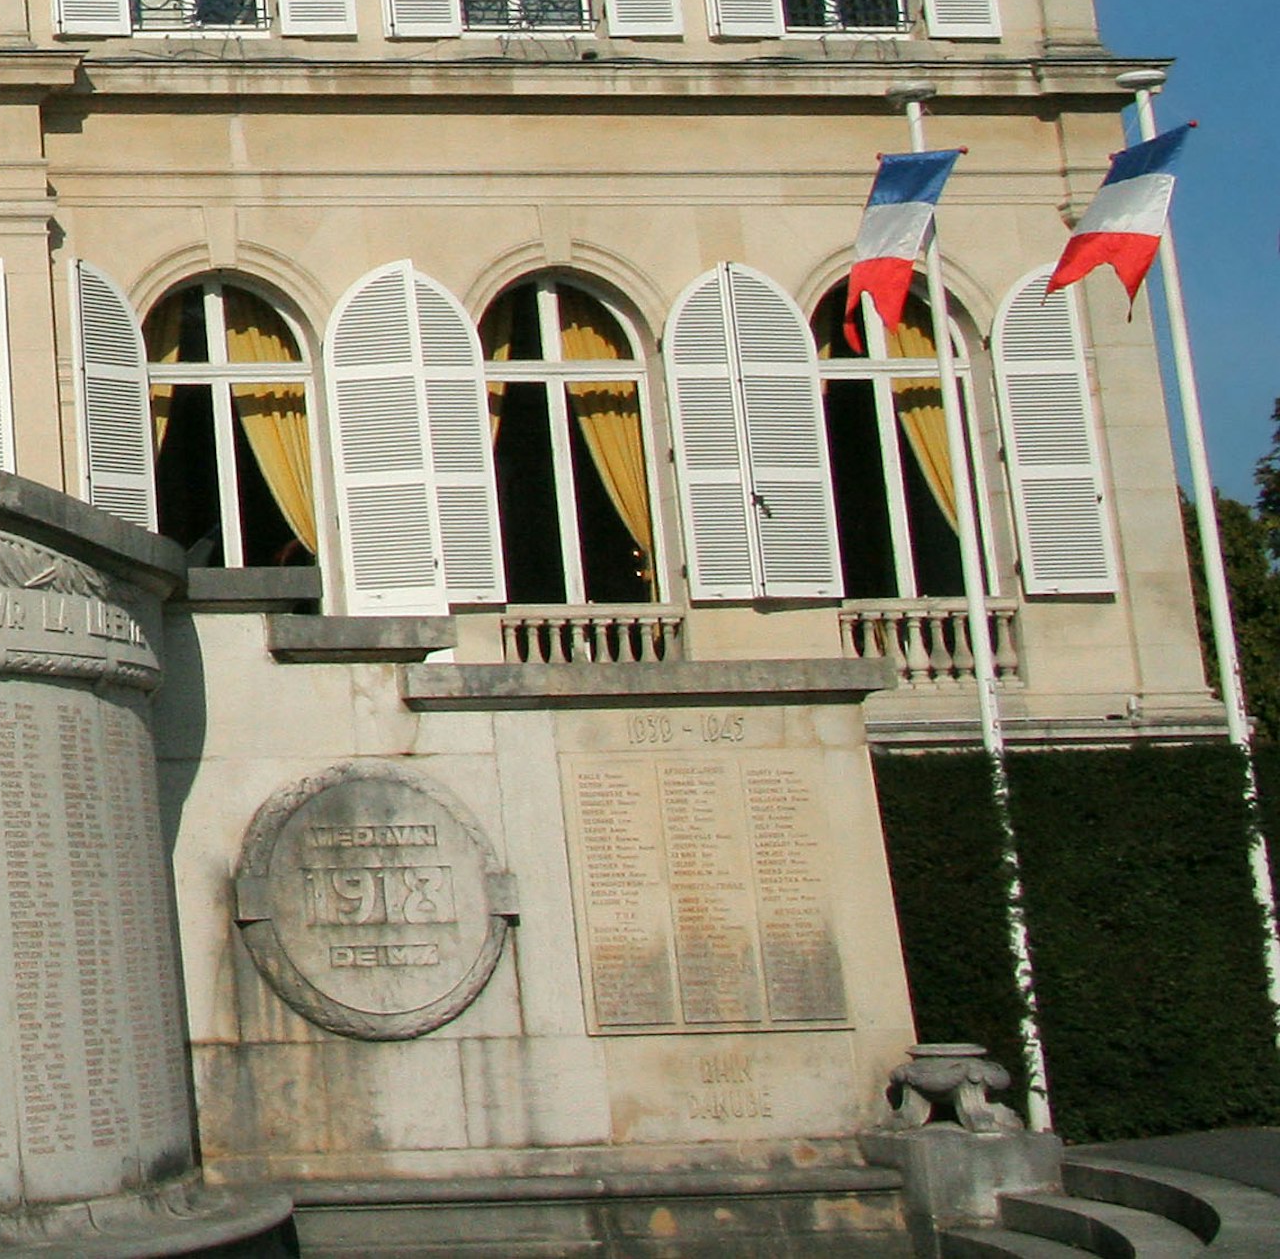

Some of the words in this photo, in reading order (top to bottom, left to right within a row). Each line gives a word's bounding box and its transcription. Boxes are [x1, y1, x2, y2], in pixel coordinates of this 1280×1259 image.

[41, 596, 74, 635] LA
[627, 713, 674, 744] 1939
[700, 712, 745, 743] 1945
[302, 865, 456, 925] 1918
